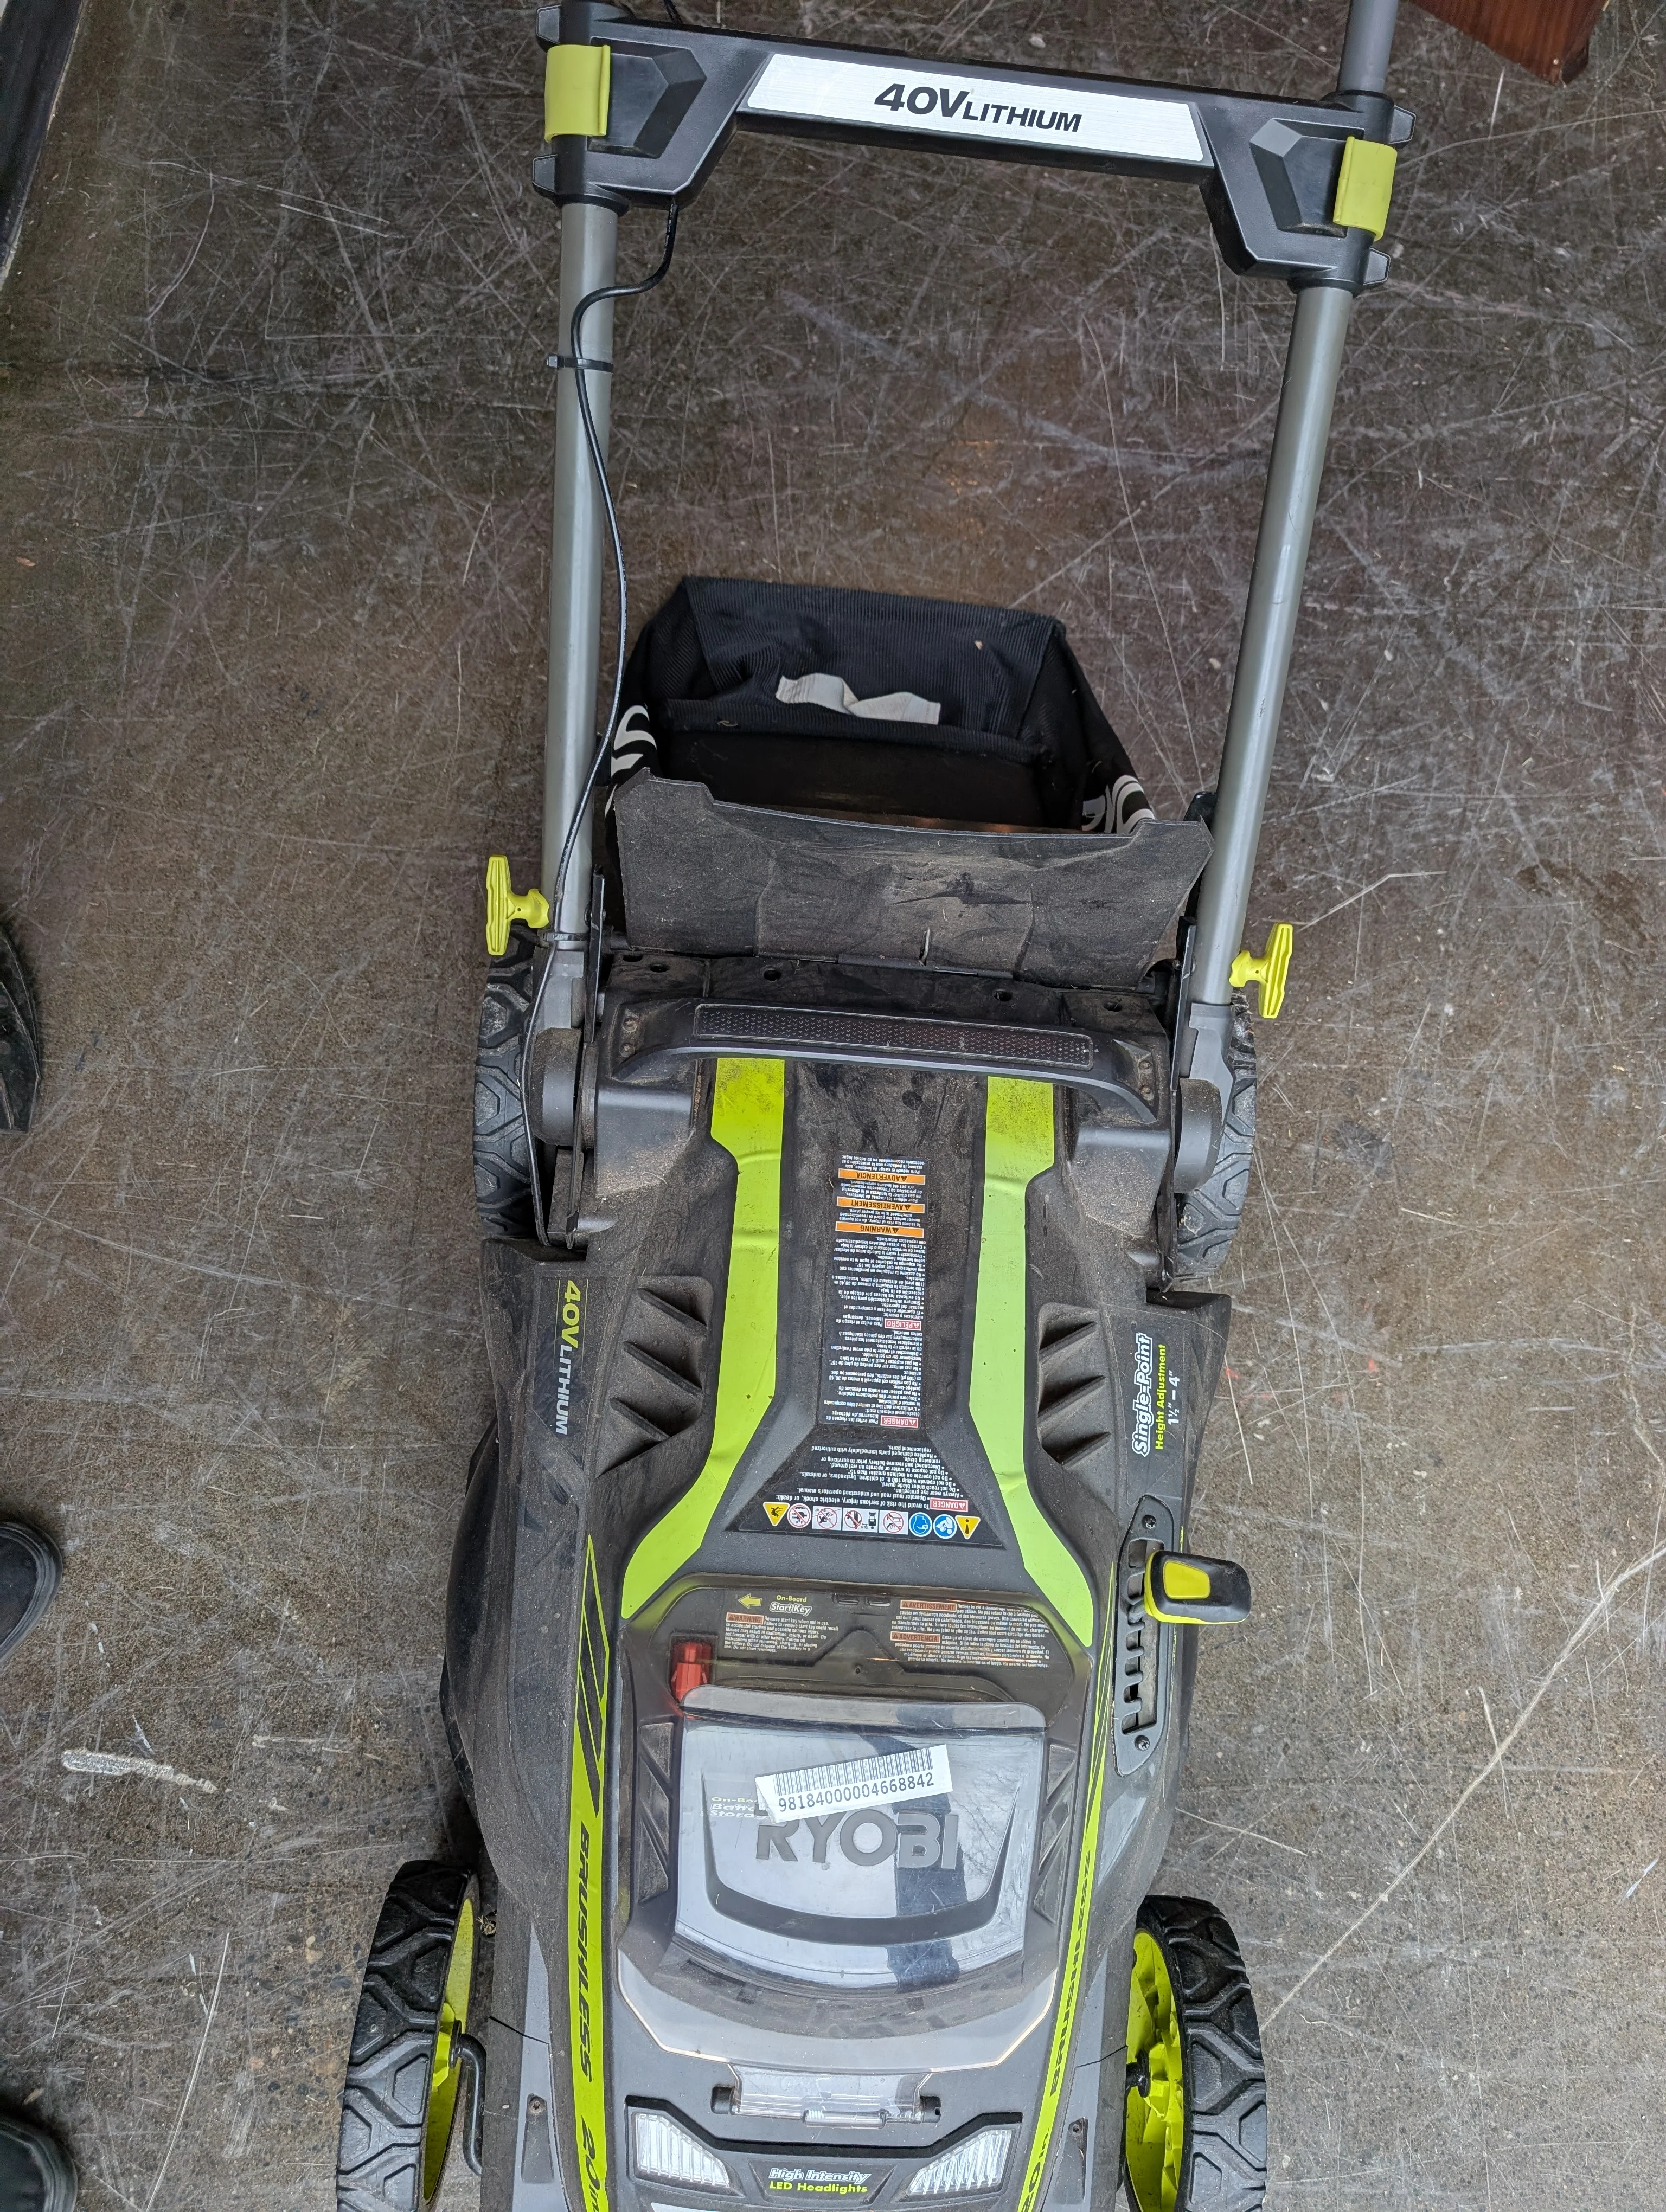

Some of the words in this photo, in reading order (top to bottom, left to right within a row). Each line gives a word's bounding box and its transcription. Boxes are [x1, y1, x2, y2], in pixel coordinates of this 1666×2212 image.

[874, 83, 970, 118] 40V
[962, 101, 1082, 132] LITHIUM
[856, 1172, 899, 1181] ADVERTENCIA
[850, 1200, 903, 1210] AVERTISSEMENT
[860, 1225, 891, 1233] WARNING
[887, 1320, 913, 1328] PELIGRO
[1156, 1344, 1166, 1408] Adjustment
[555, 1345, 572, 1435] LITHIUM
[1132, 1332, 1154, 1457] Single-Point
[883, 1417, 908, 1425] DANGER
[1155, 1411, 1166, 1449] Height
[847, 1446, 878, 1455] immediately
[901, 1445, 931, 1453] replacement
[913, 1451, 933, 1459] Replace
[826, 1456, 849, 1464] servicing
[918, 1456, 941, 1464] removing
[828, 1472, 856, 1480] bystanders,
[913, 1472, 932, 1480] operate
[817, 1487, 842, 1495] operator's
[893, 1487, 920, 1495] protection.
[800, 1494, 819, 1503] shock,
[841, 1497, 858, 1505] injury,
[776, 1595, 807, 1603] On-Board
[770, 1601, 793, 1615] Start
[791, 1604, 812, 1617] Key
[909, 1602, 954, 1610] AVERTISSEMENT
[734, 1615, 761, 1623] WARNING
[899, 1634, 938, 1642] ADVERTENCIA
[778, 1772, 934, 1813] 98184000004668842
[757, 1808, 958, 1870] RYOBI
[578, 1821, 592, 2083] BRUSHLESS
[1049, 1850, 1091, 2097] BRUSHLESS
[768, 2168, 804, 2181] High
[805, 2170, 872, 2184] Intensity
[770, 2181, 792, 2190] LED
[797, 2183, 867, 2194] Headlights
